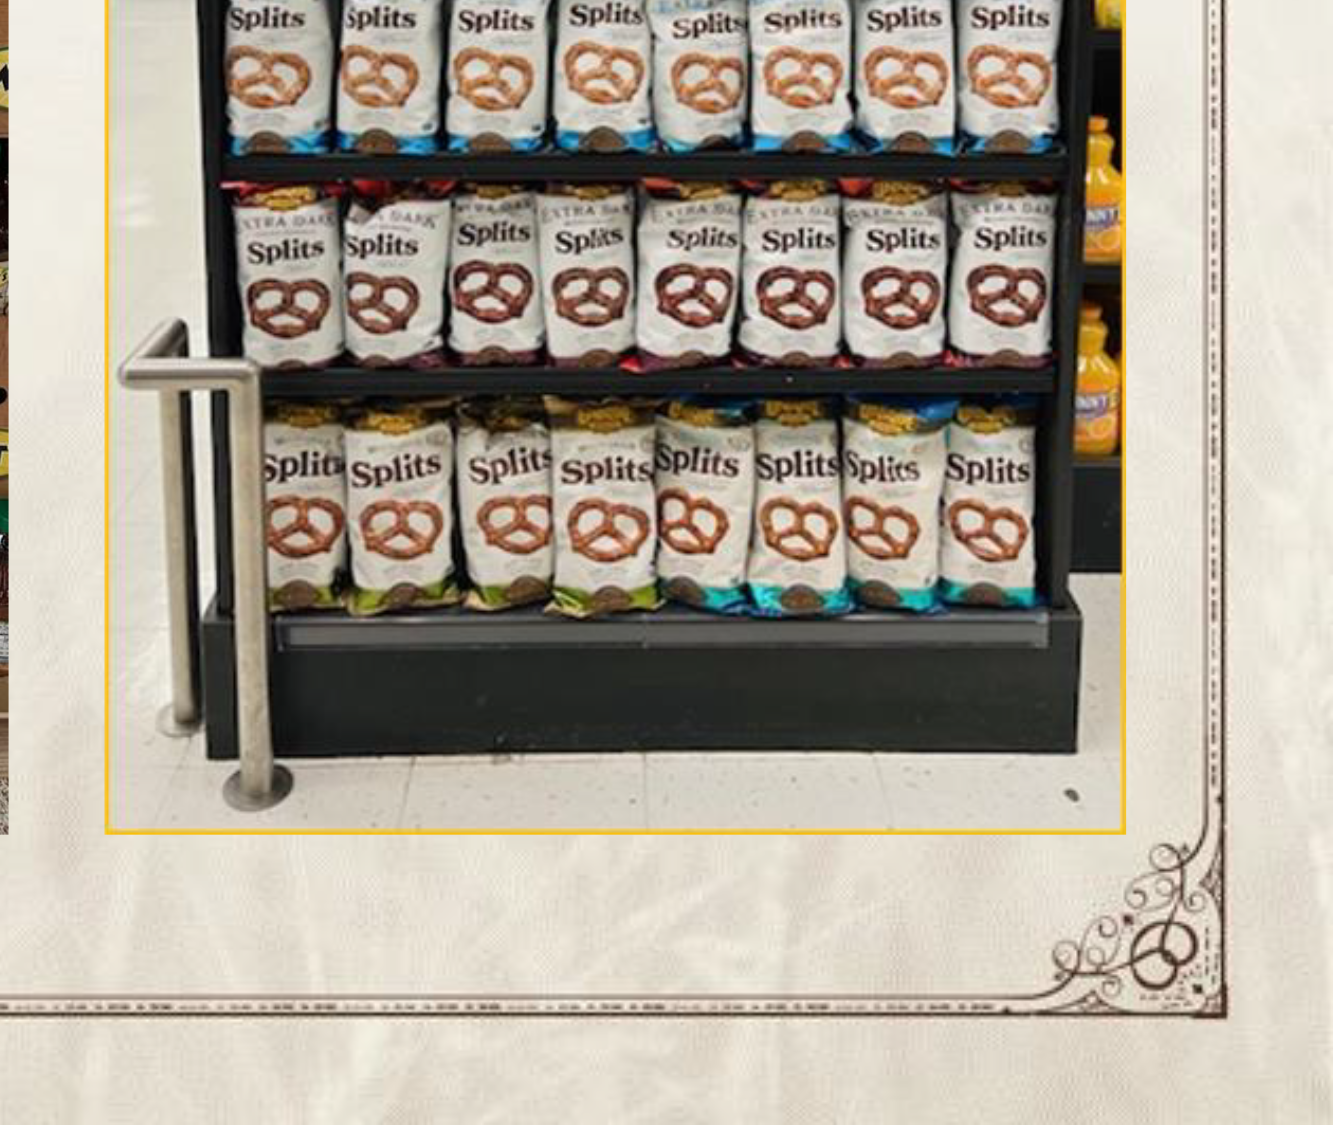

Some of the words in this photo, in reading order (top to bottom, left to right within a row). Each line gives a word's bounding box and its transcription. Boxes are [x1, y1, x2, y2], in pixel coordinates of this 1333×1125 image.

[570, 2, 644, 27] Splits
[673, 13, 749, 40] Splits
[764, 8, 842, 31] Splits
[347, 234, 419, 260] Splits
[457, 222, 531, 247] Splits
[264, 451, 346, 482] Splits
[351, 453, 442, 488] Splits
[470, 446, 553, 485] Splits
[654, 443, 740, 477] Splits
